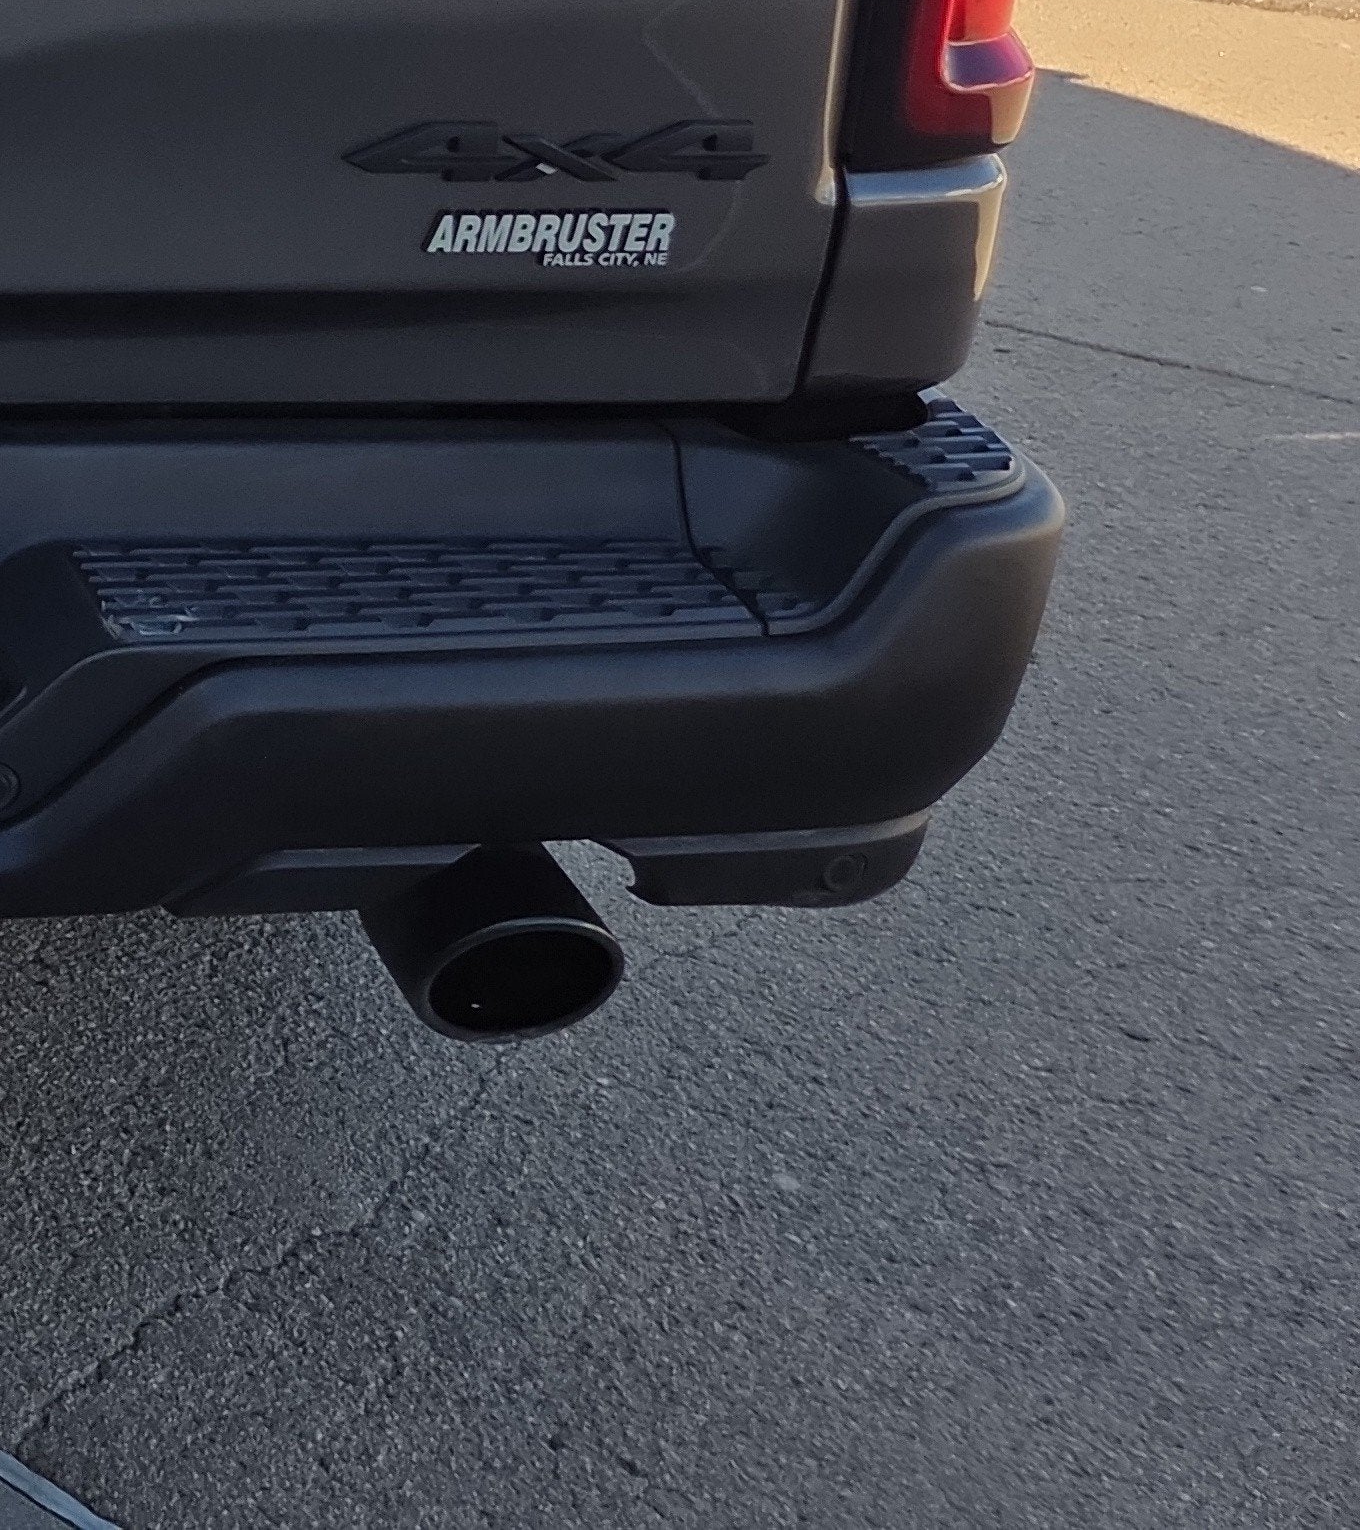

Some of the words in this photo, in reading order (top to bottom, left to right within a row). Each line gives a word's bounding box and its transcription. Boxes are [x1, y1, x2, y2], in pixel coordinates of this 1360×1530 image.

[427, 213, 675, 254] ARMBRUSTER
[543, 253, 596, 267] FALLS
[598, 253, 639, 268] CITY,
[644, 253, 669, 267] NE
